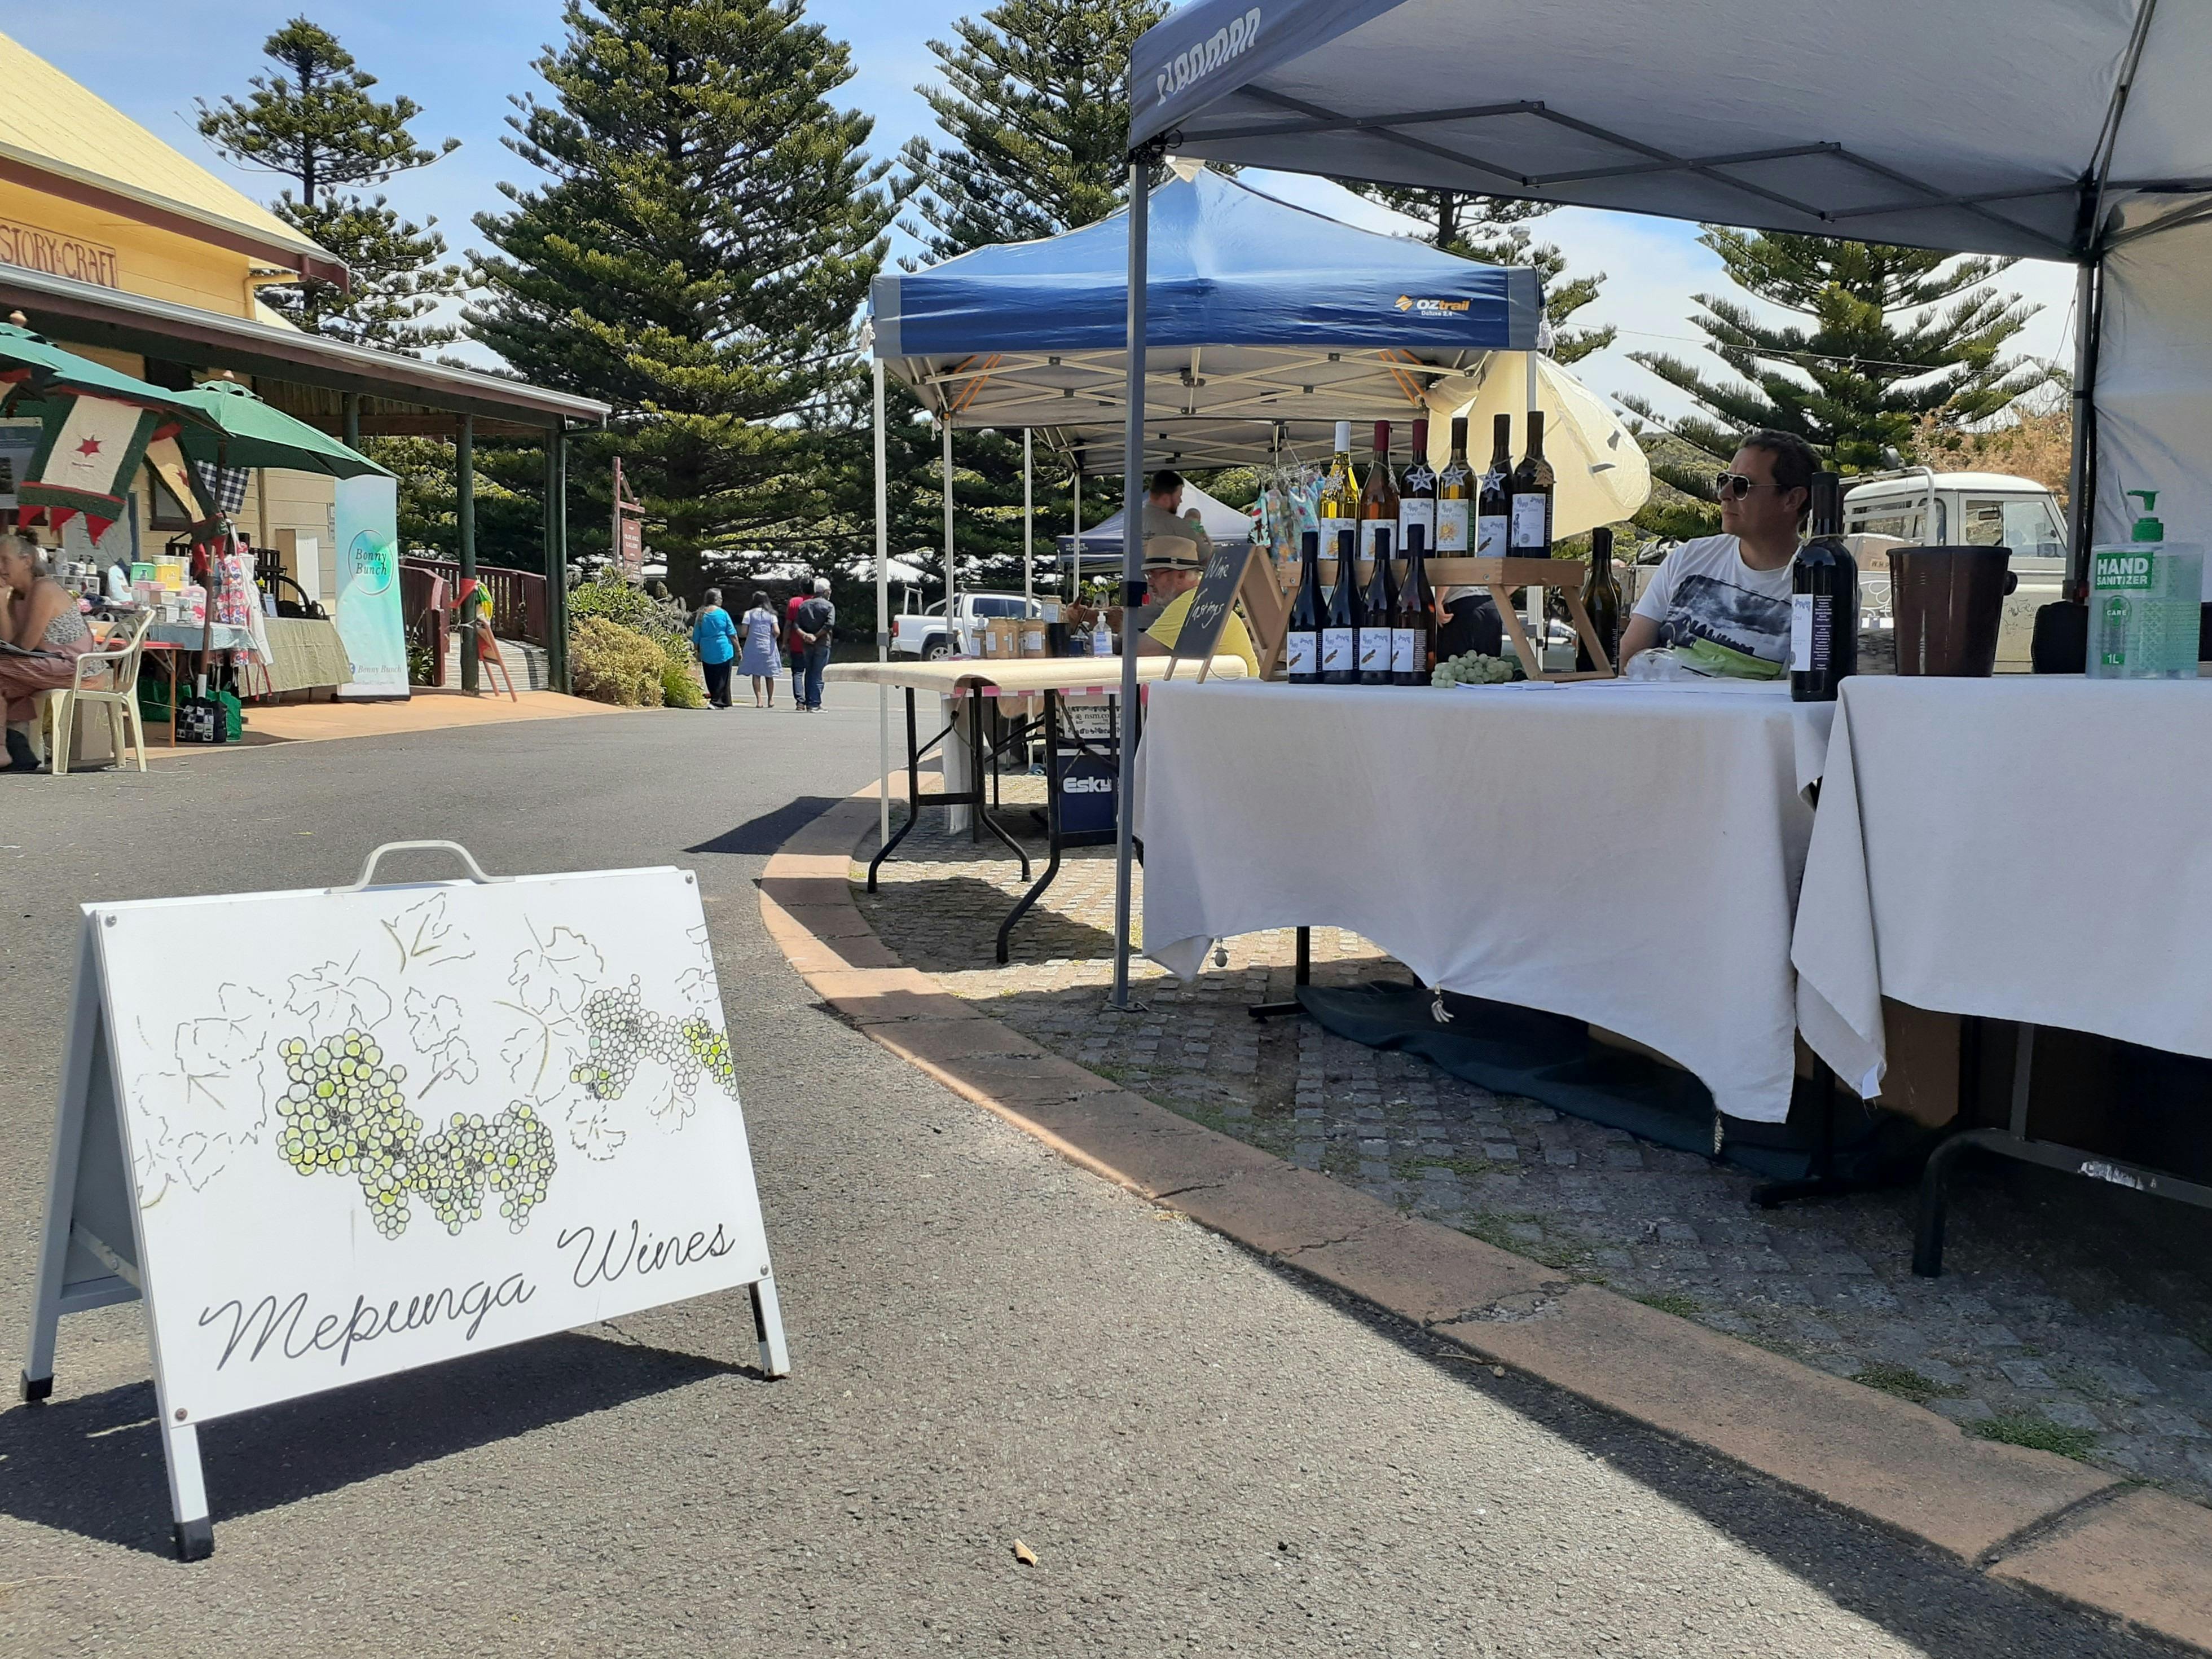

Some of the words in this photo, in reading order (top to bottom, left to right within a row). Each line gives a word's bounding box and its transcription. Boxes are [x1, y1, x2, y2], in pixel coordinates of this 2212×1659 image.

[62, 241, 116, 289] CRAFT
[1417, 299, 1470, 311] OZtrail
[355, 548, 386, 565] Bonny
[355, 562, 387, 575] Bunch
[1205, 553, 1230, 579] Wine
[2096, 557, 2149, 575] HAND
[2096, 575, 2148, 586] SANITIZER
[1185, 587, 1225, 629] Tastings
[2107, 654, 2119, 664] 1L
[358, 665, 379, 676] Bonny
[381, 663, 402, 673] Bunch
[1063, 776, 1112, 794] Esky
[198, 1272, 536, 1372] Mepunga
[557, 1218, 736, 1289] Wines
